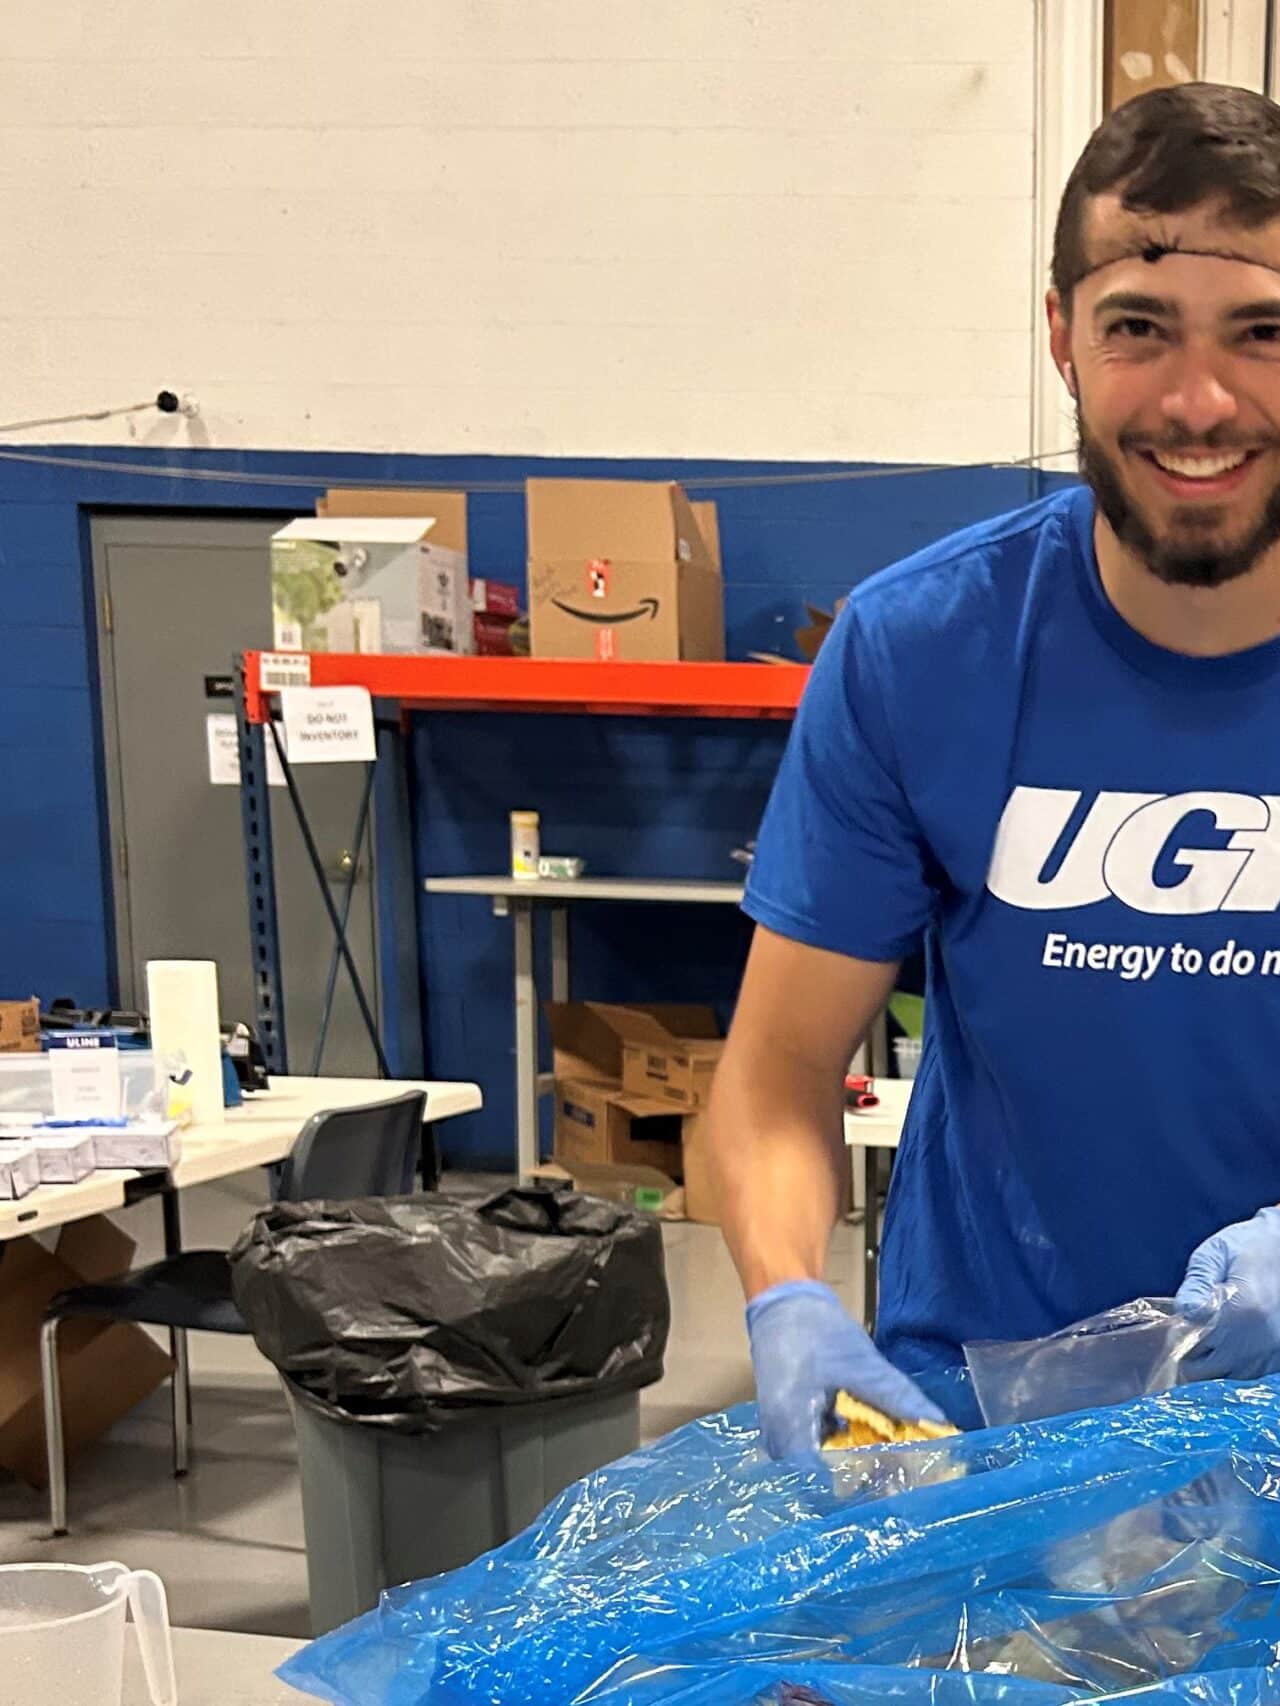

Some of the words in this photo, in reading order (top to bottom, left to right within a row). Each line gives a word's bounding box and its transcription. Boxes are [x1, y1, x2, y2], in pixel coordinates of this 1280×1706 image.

[307, 712, 324, 725] DO
[326, 711, 348, 725] NOT
[300, 729, 359, 743] INVENTORY
[1042, 933, 1164, 981] Energy
[1171, 942, 1202, 974] to
[1209, 940, 1255, 976] do
[66, 1036, 100, 1049] ULINE
